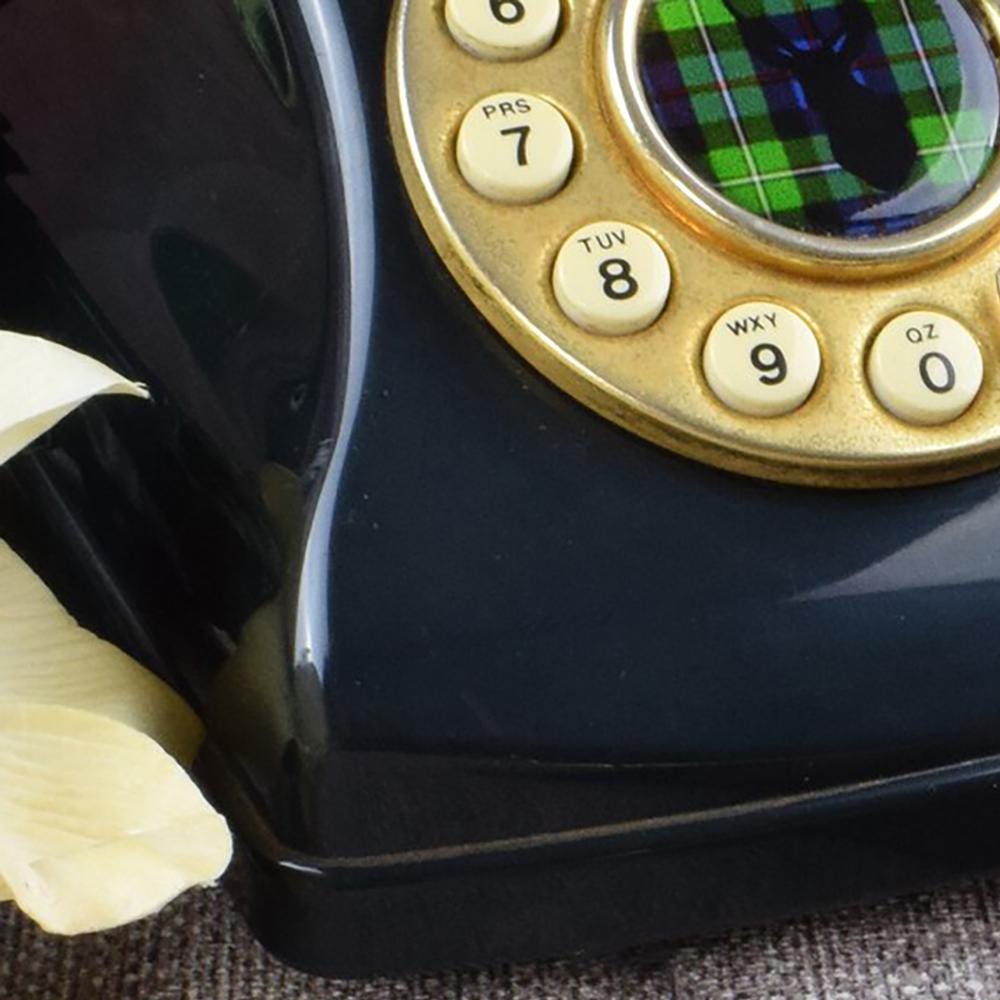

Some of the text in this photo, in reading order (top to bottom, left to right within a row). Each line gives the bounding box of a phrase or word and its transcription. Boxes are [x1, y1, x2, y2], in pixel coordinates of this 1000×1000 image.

[482, 98, 532, 120] PRS
[500, 125, 532, 167] 7
[577, 230, 628, 254] TUV
[598, 258, 639, 300] 8
[726, 312, 778, 337] WXY
[906, 323, 940, 345] QZ
[750, 343, 788, 386] 9
